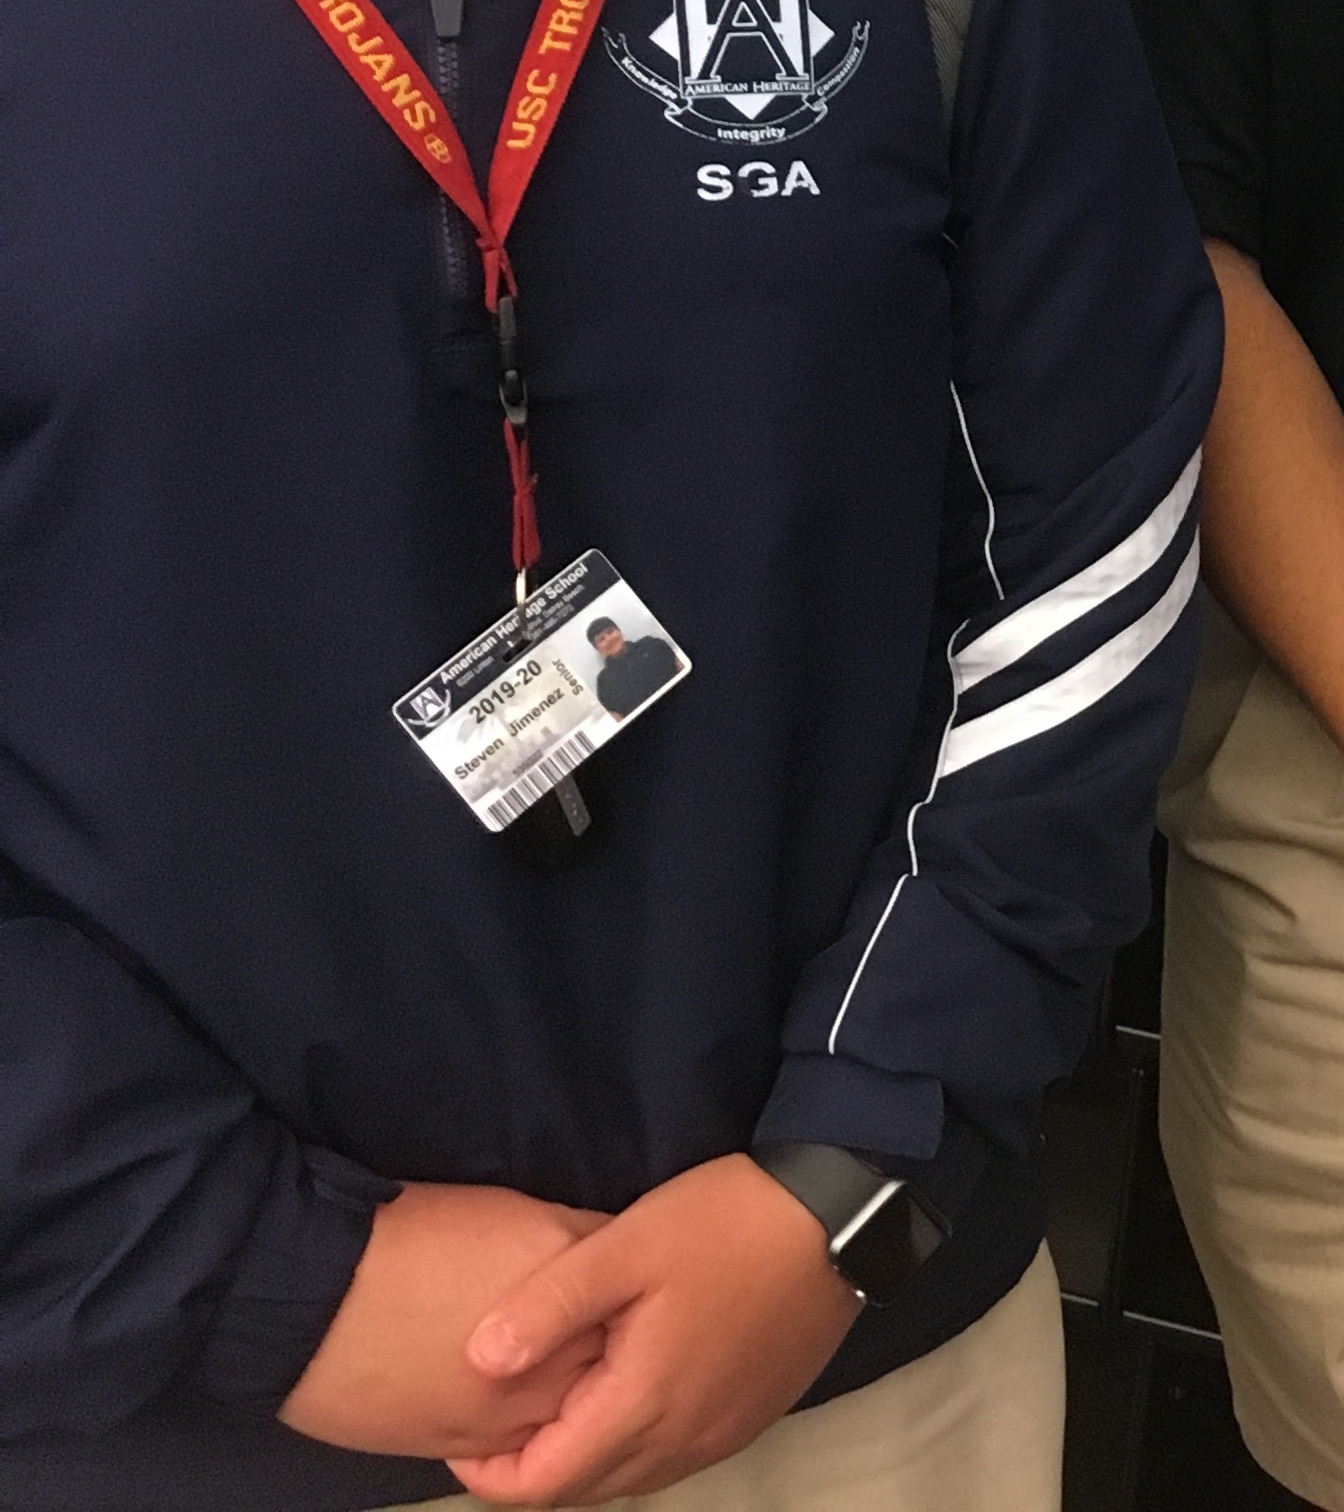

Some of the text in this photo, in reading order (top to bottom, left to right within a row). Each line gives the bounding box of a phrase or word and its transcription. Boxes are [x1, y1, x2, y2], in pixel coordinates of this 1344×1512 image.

[507, 69, 558, 152] USC
[684, 82, 748, 96] AMERICAN
[717, 126, 786, 142] Integrity
[696, 160, 821, 201] SGA
[438, 633, 498, 685] American
[544, 562, 589, 599] School
[468, 659, 542, 725] 2019-20
[552, 658, 584, 696] Senior
[453, 737, 505, 781] Steven
[508, 686, 565, 738] Jimenez
